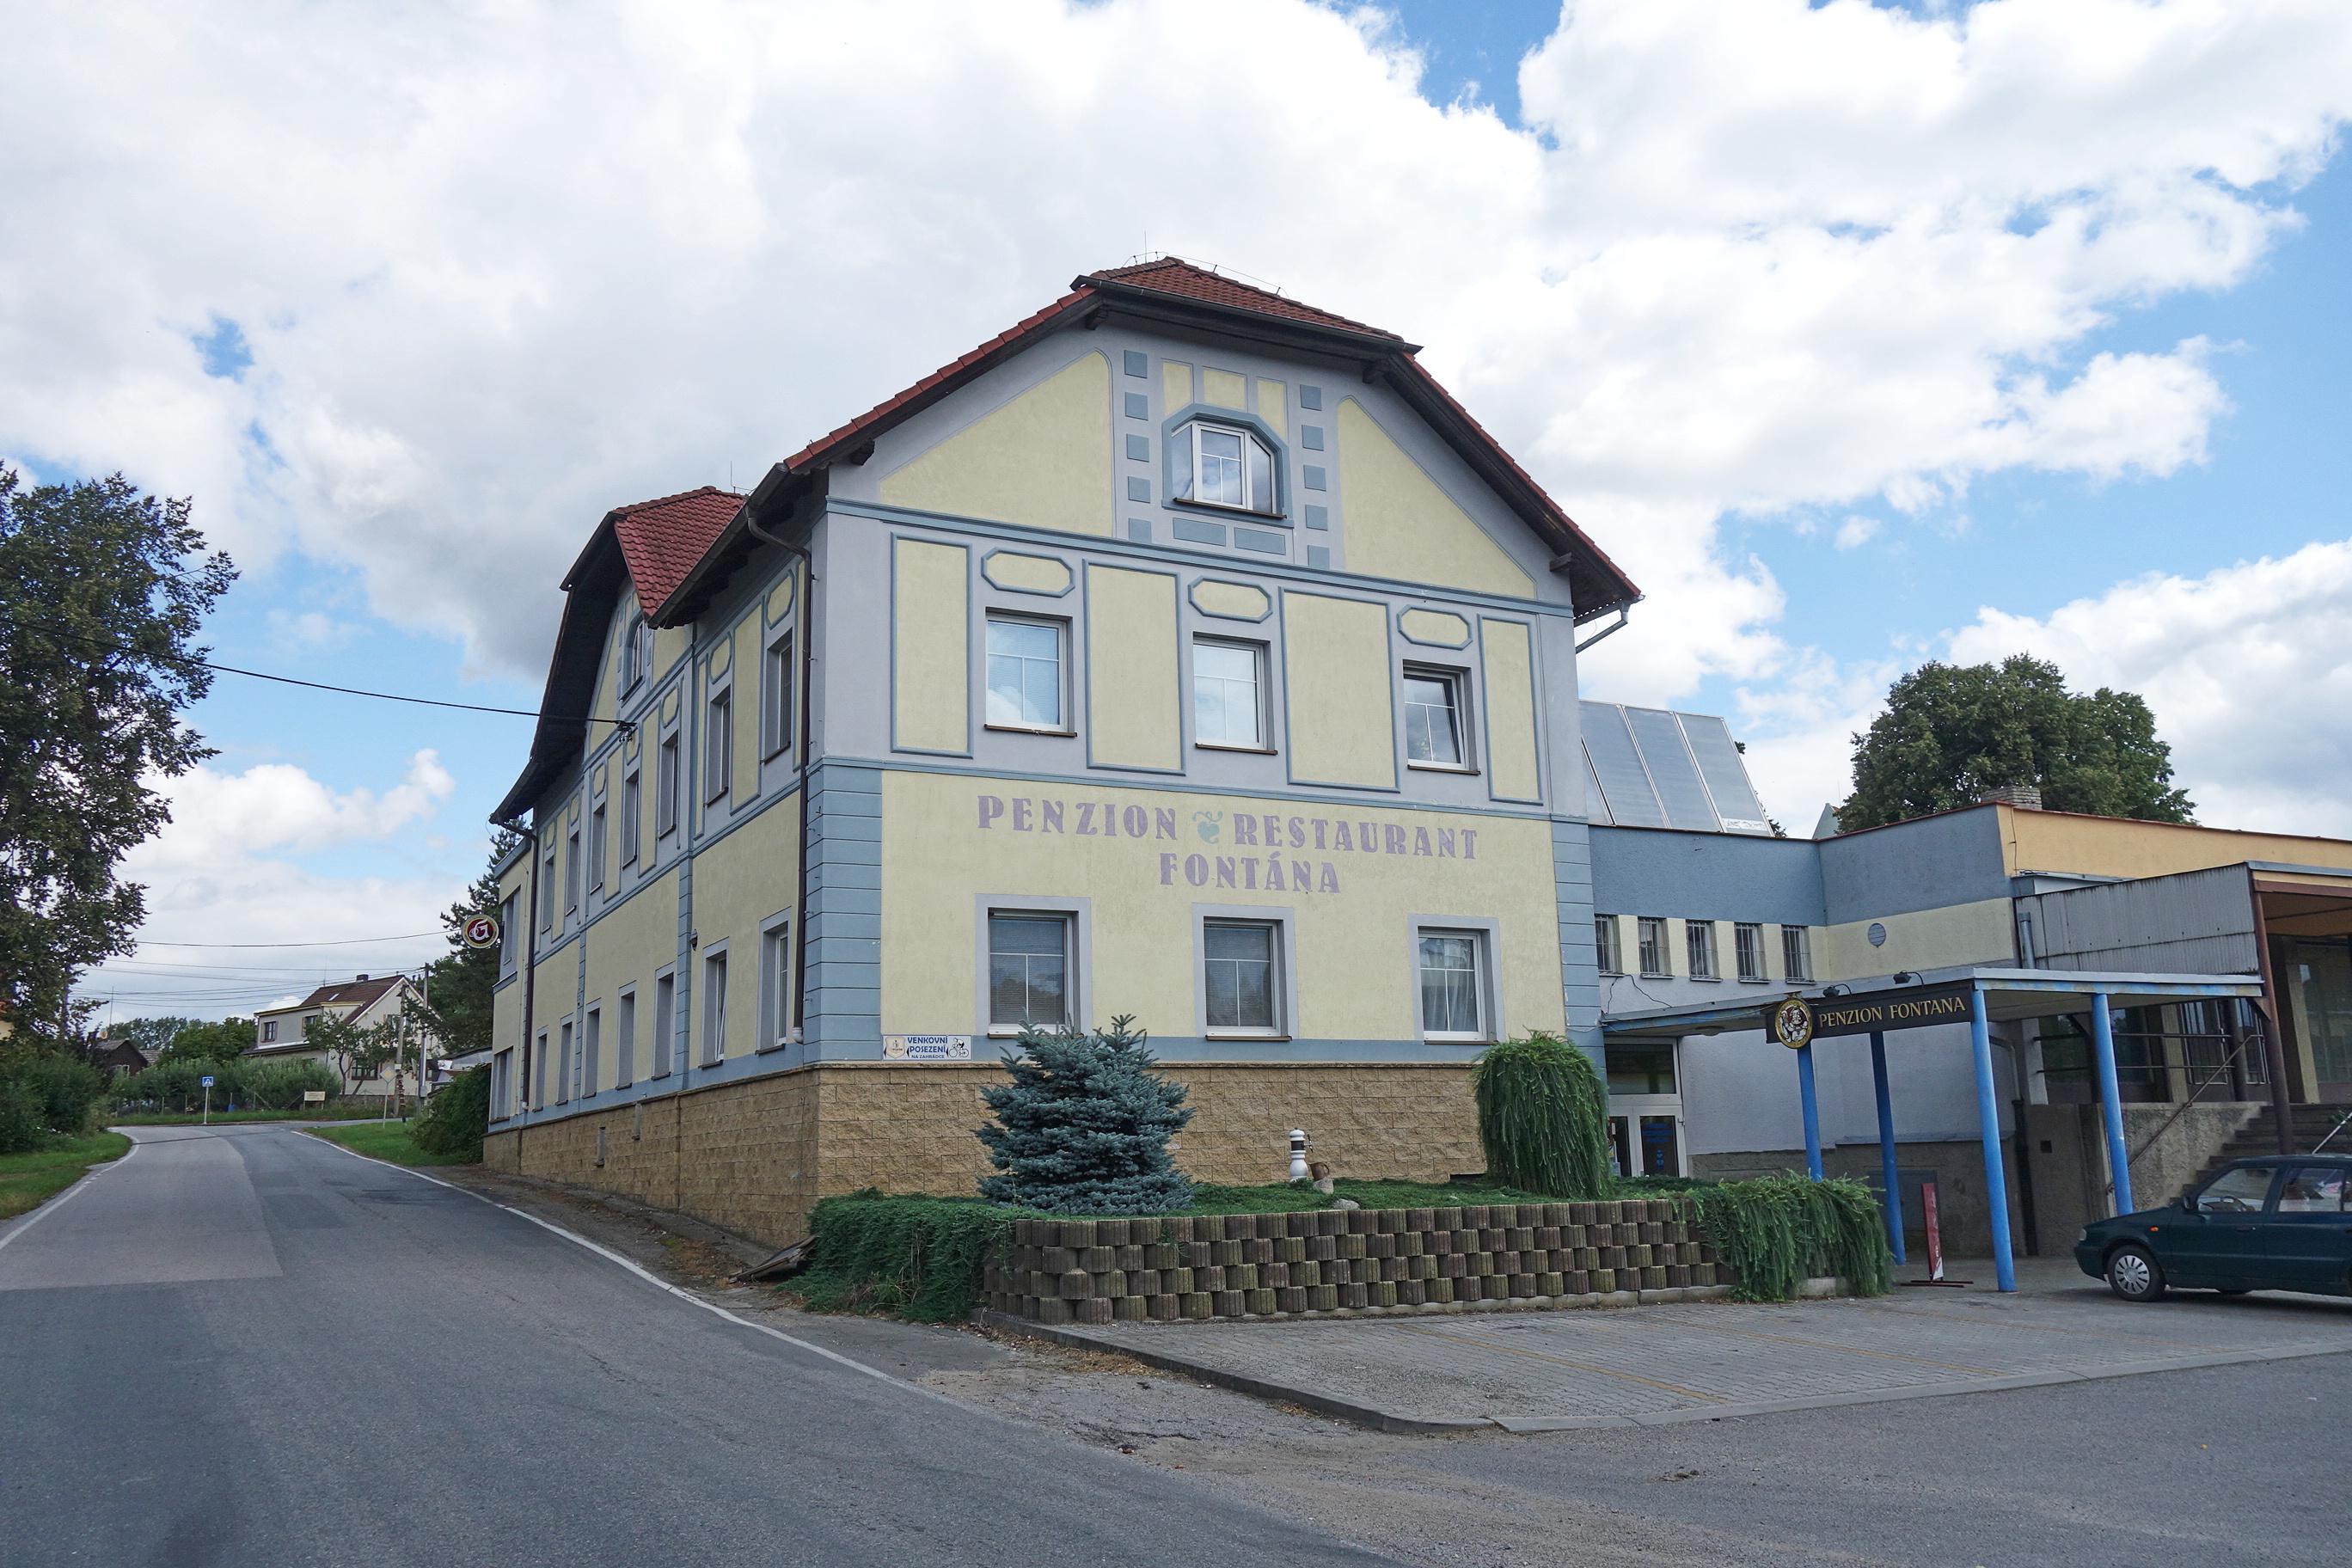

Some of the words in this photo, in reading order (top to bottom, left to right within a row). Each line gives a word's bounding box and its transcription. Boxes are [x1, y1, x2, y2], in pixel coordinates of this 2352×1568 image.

[977, 794, 1178, 841] PENZION
[1233, 812, 1478, 861] RESTAURANT
[1159, 850, 1341, 894] FONTÁNA
[1819, 1006, 1883, 1028] PENZION
[1889, 995, 1967, 1020] FONTANA
[907, 1035, 948, 1044] VENKOVNÍ
[909, 1044, 946, 1053] POSEZENÍ
